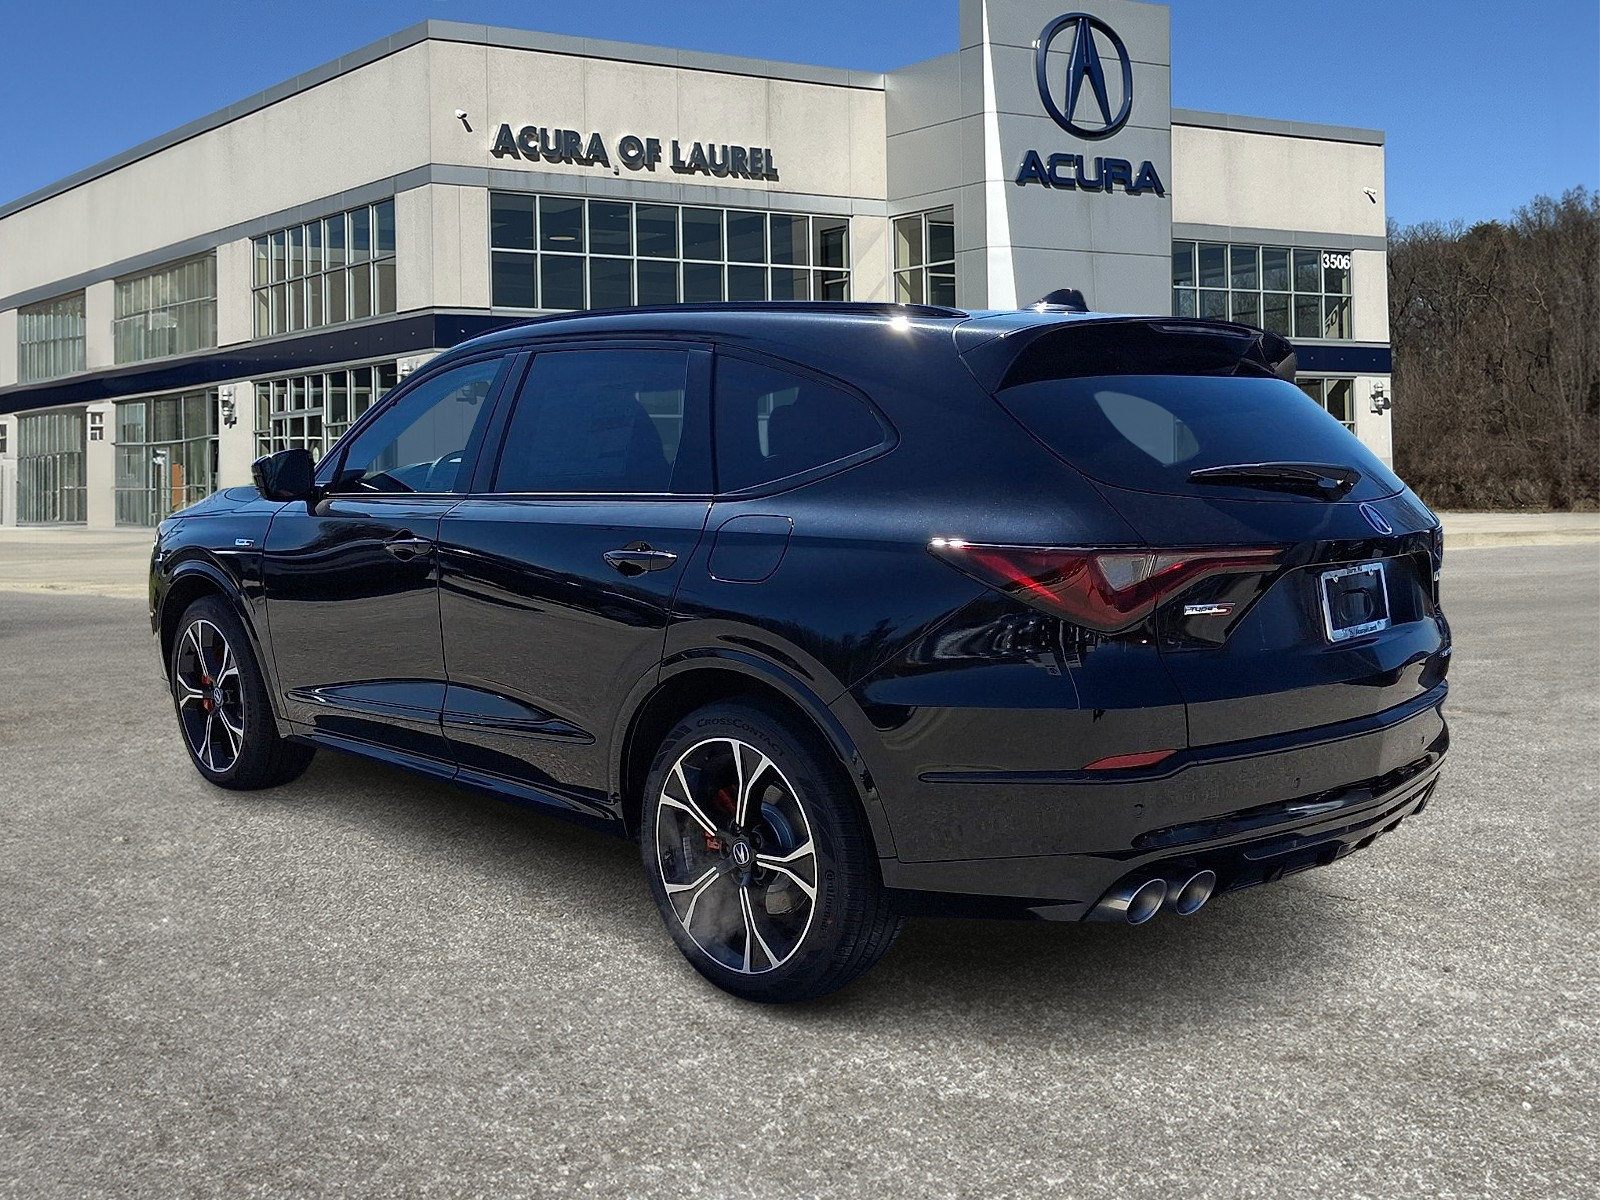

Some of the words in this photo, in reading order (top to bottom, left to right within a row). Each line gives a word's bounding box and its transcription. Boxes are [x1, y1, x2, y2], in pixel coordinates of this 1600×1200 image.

[490, 123, 611, 168] ACURA
[616, 135, 662, 172] OF
[669, 139, 779, 182] LAUREL
[1015, 149, 1165, 198] ACURA
[1322, 253, 1351, 270] 3506
